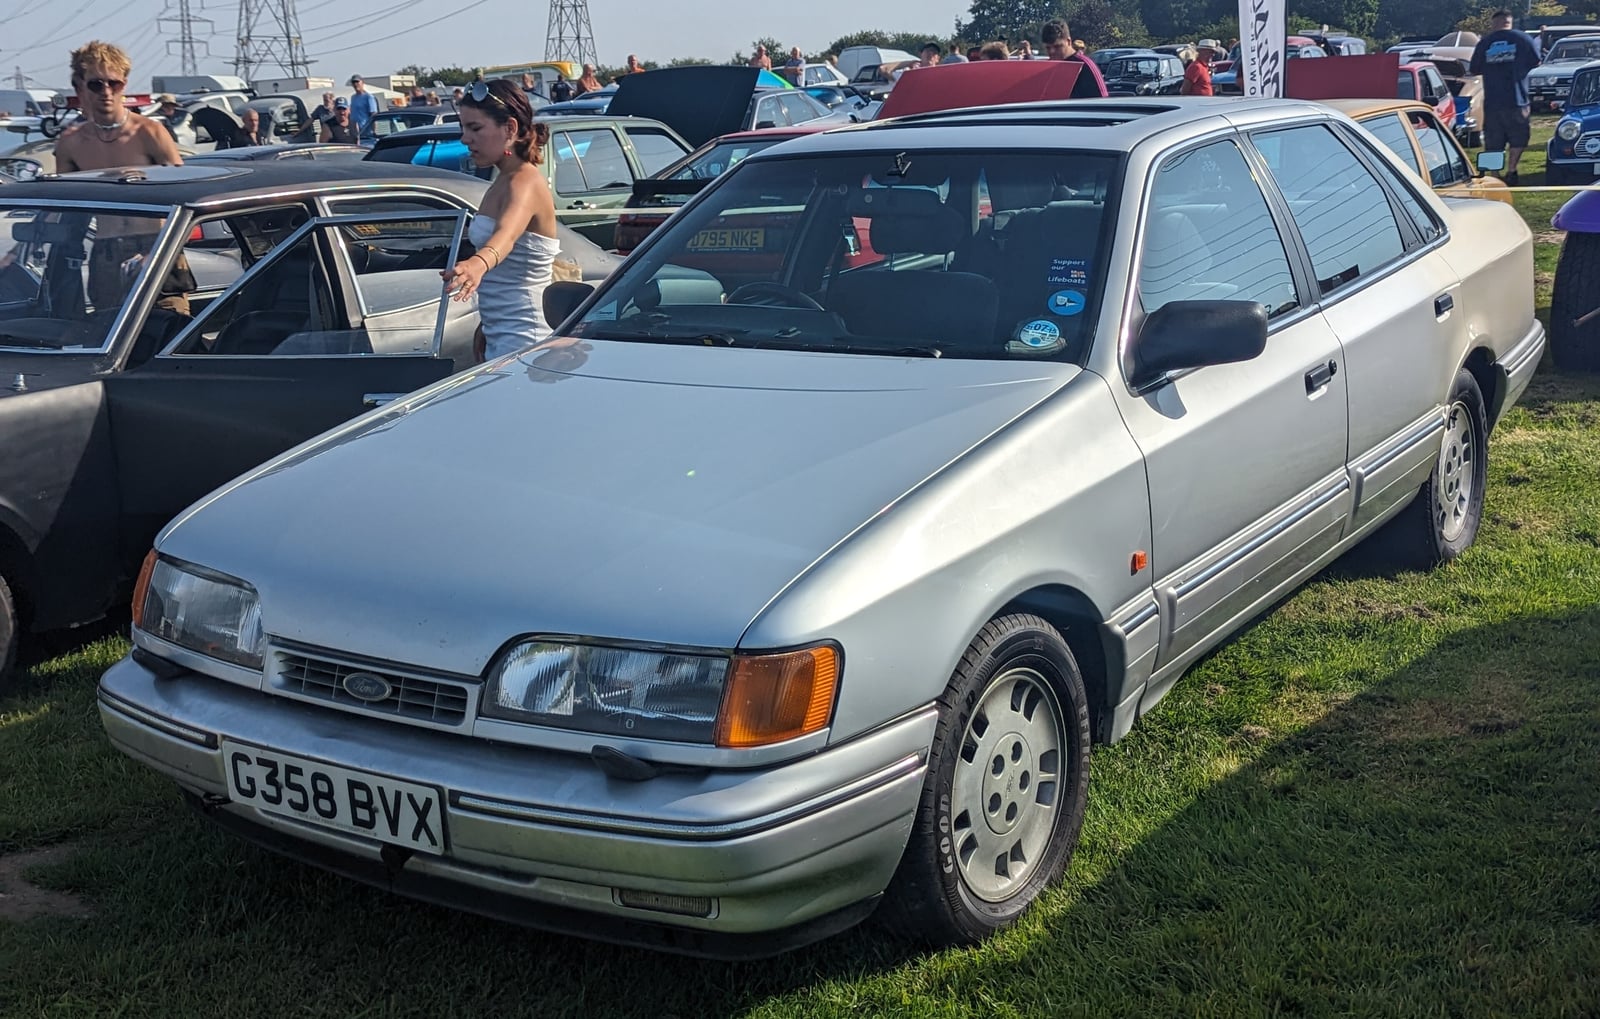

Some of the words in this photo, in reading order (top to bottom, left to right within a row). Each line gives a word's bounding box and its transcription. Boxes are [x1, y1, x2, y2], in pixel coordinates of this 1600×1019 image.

[730, 230, 760, 248] NKE
[1052, 258, 1086, 267] Support
[1047, 275, 1086, 285] Lifeboats
[231, 751, 338, 820] G358
[346, 778, 438, 847] BVX
